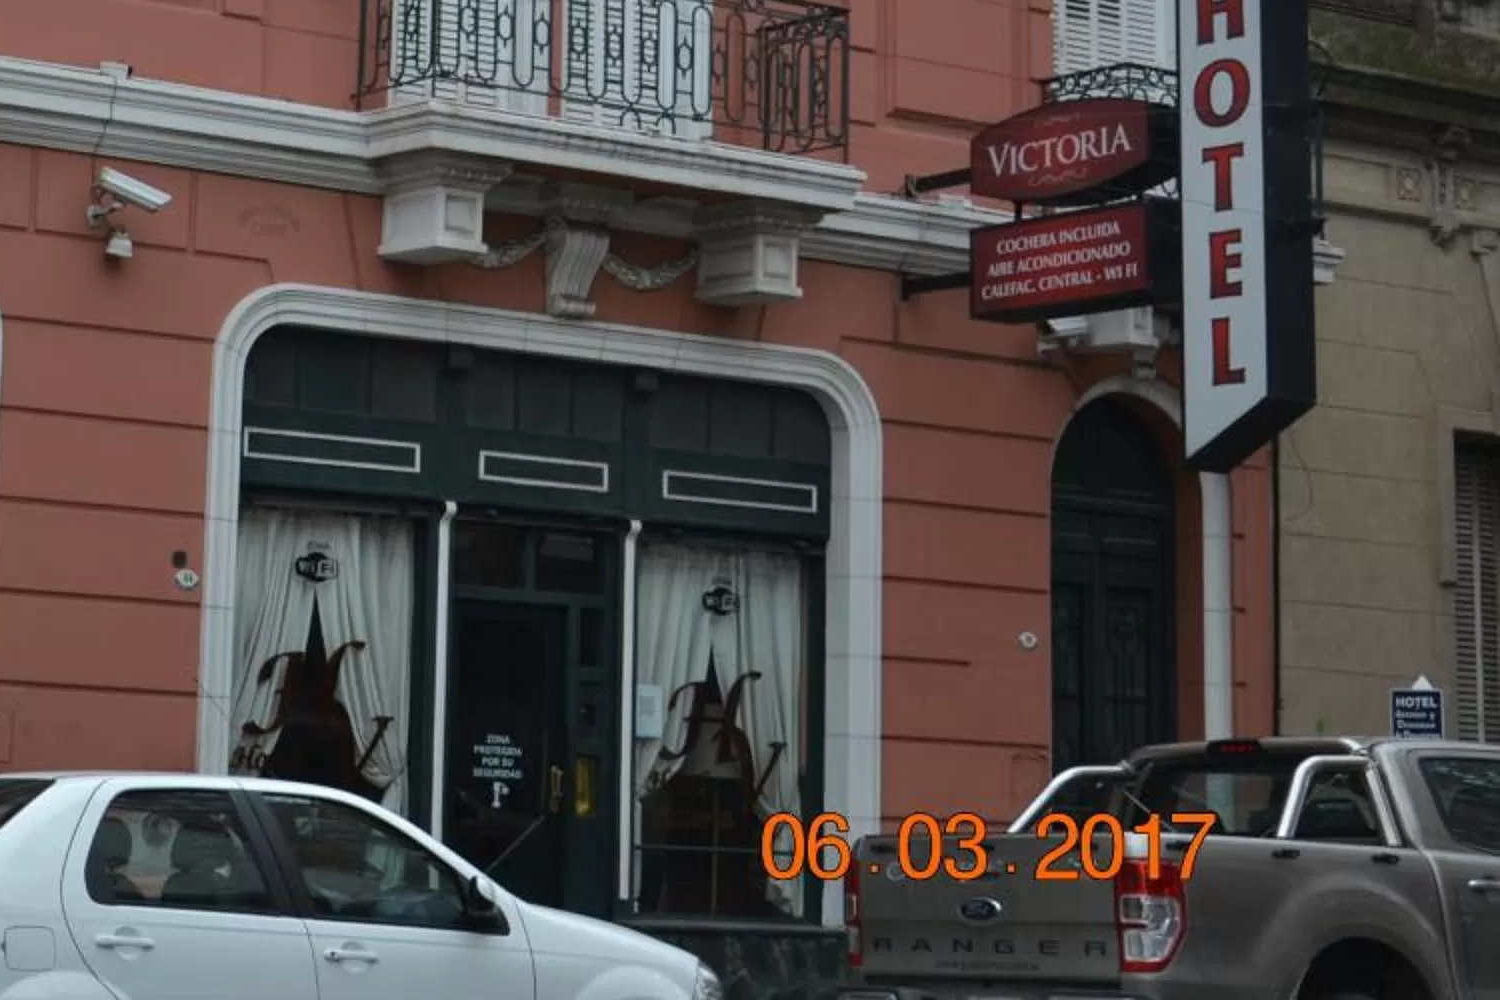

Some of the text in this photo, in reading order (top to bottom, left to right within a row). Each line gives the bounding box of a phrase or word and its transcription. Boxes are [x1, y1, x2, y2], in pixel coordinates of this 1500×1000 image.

[987, 122, 1132, 178] VICTORIA
[996, 219, 1121, 255] COCHERA INCLUIDA
[987, 241, 1131, 278] AIRE ACONDICIONADO
[1038, 270, 1095, 292] CENTRAL
[1395, 696, 1438, 709] HOTEL
[873, 937, 1107, 958] RANGER
